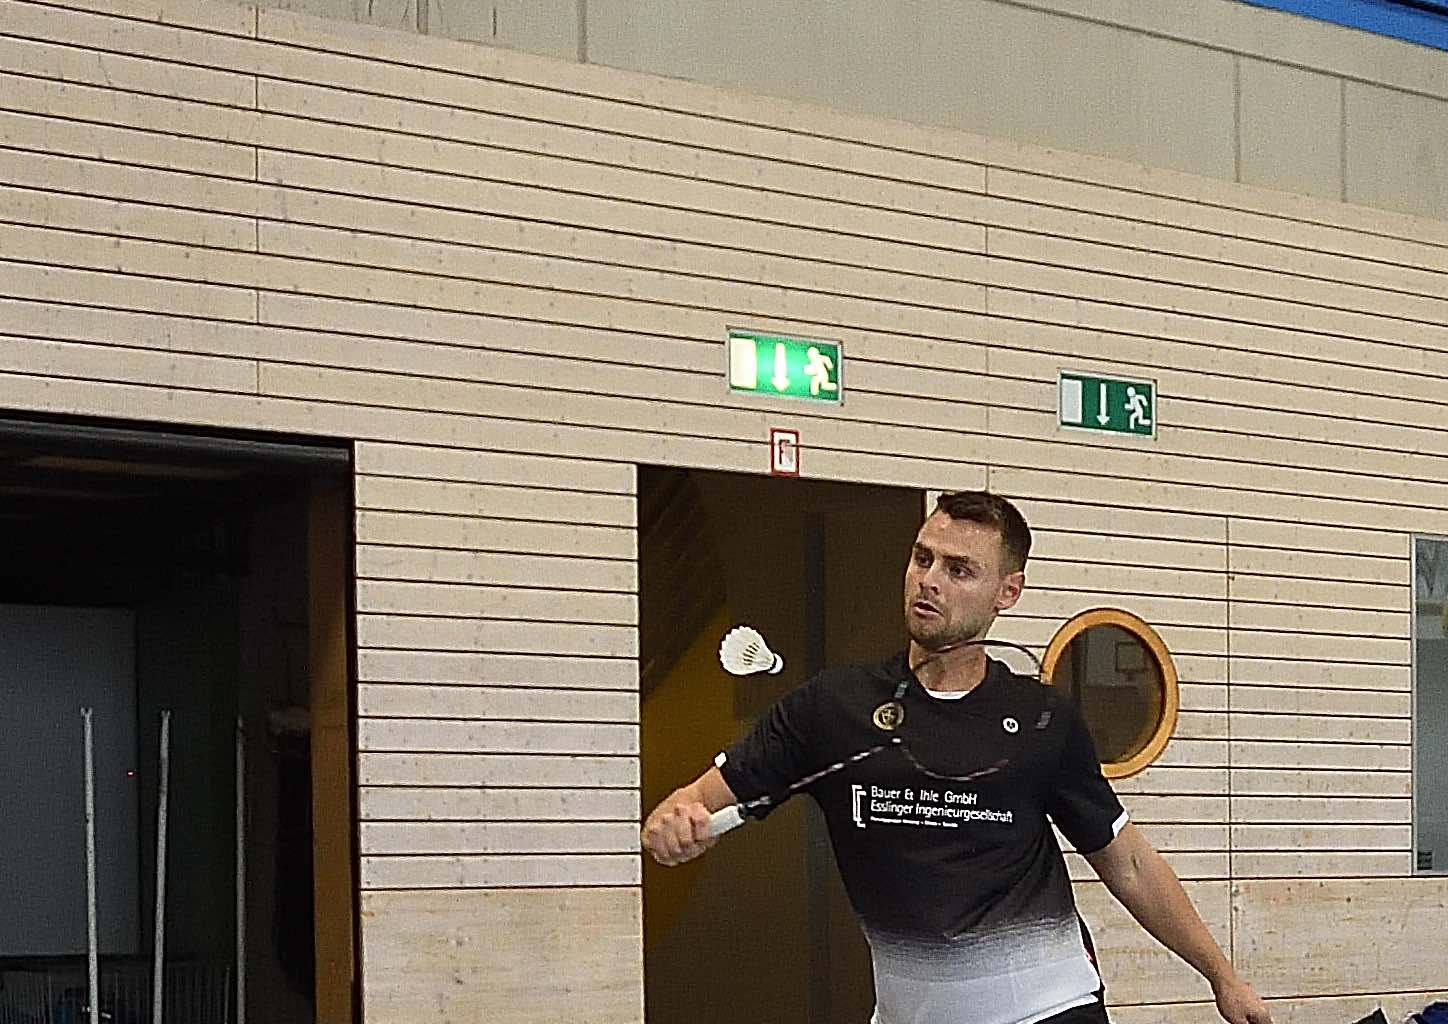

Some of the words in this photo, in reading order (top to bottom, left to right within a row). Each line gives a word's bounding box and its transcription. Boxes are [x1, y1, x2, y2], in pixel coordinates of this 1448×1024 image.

[871, 785, 900, 799] Bauer
[920, 789, 939, 802] Ihle
[945, 791, 977, 805] GmbH
[870, 800, 913, 816] Esslinger
[915, 803, 1013, 823] Ingenieurgesellschaft
